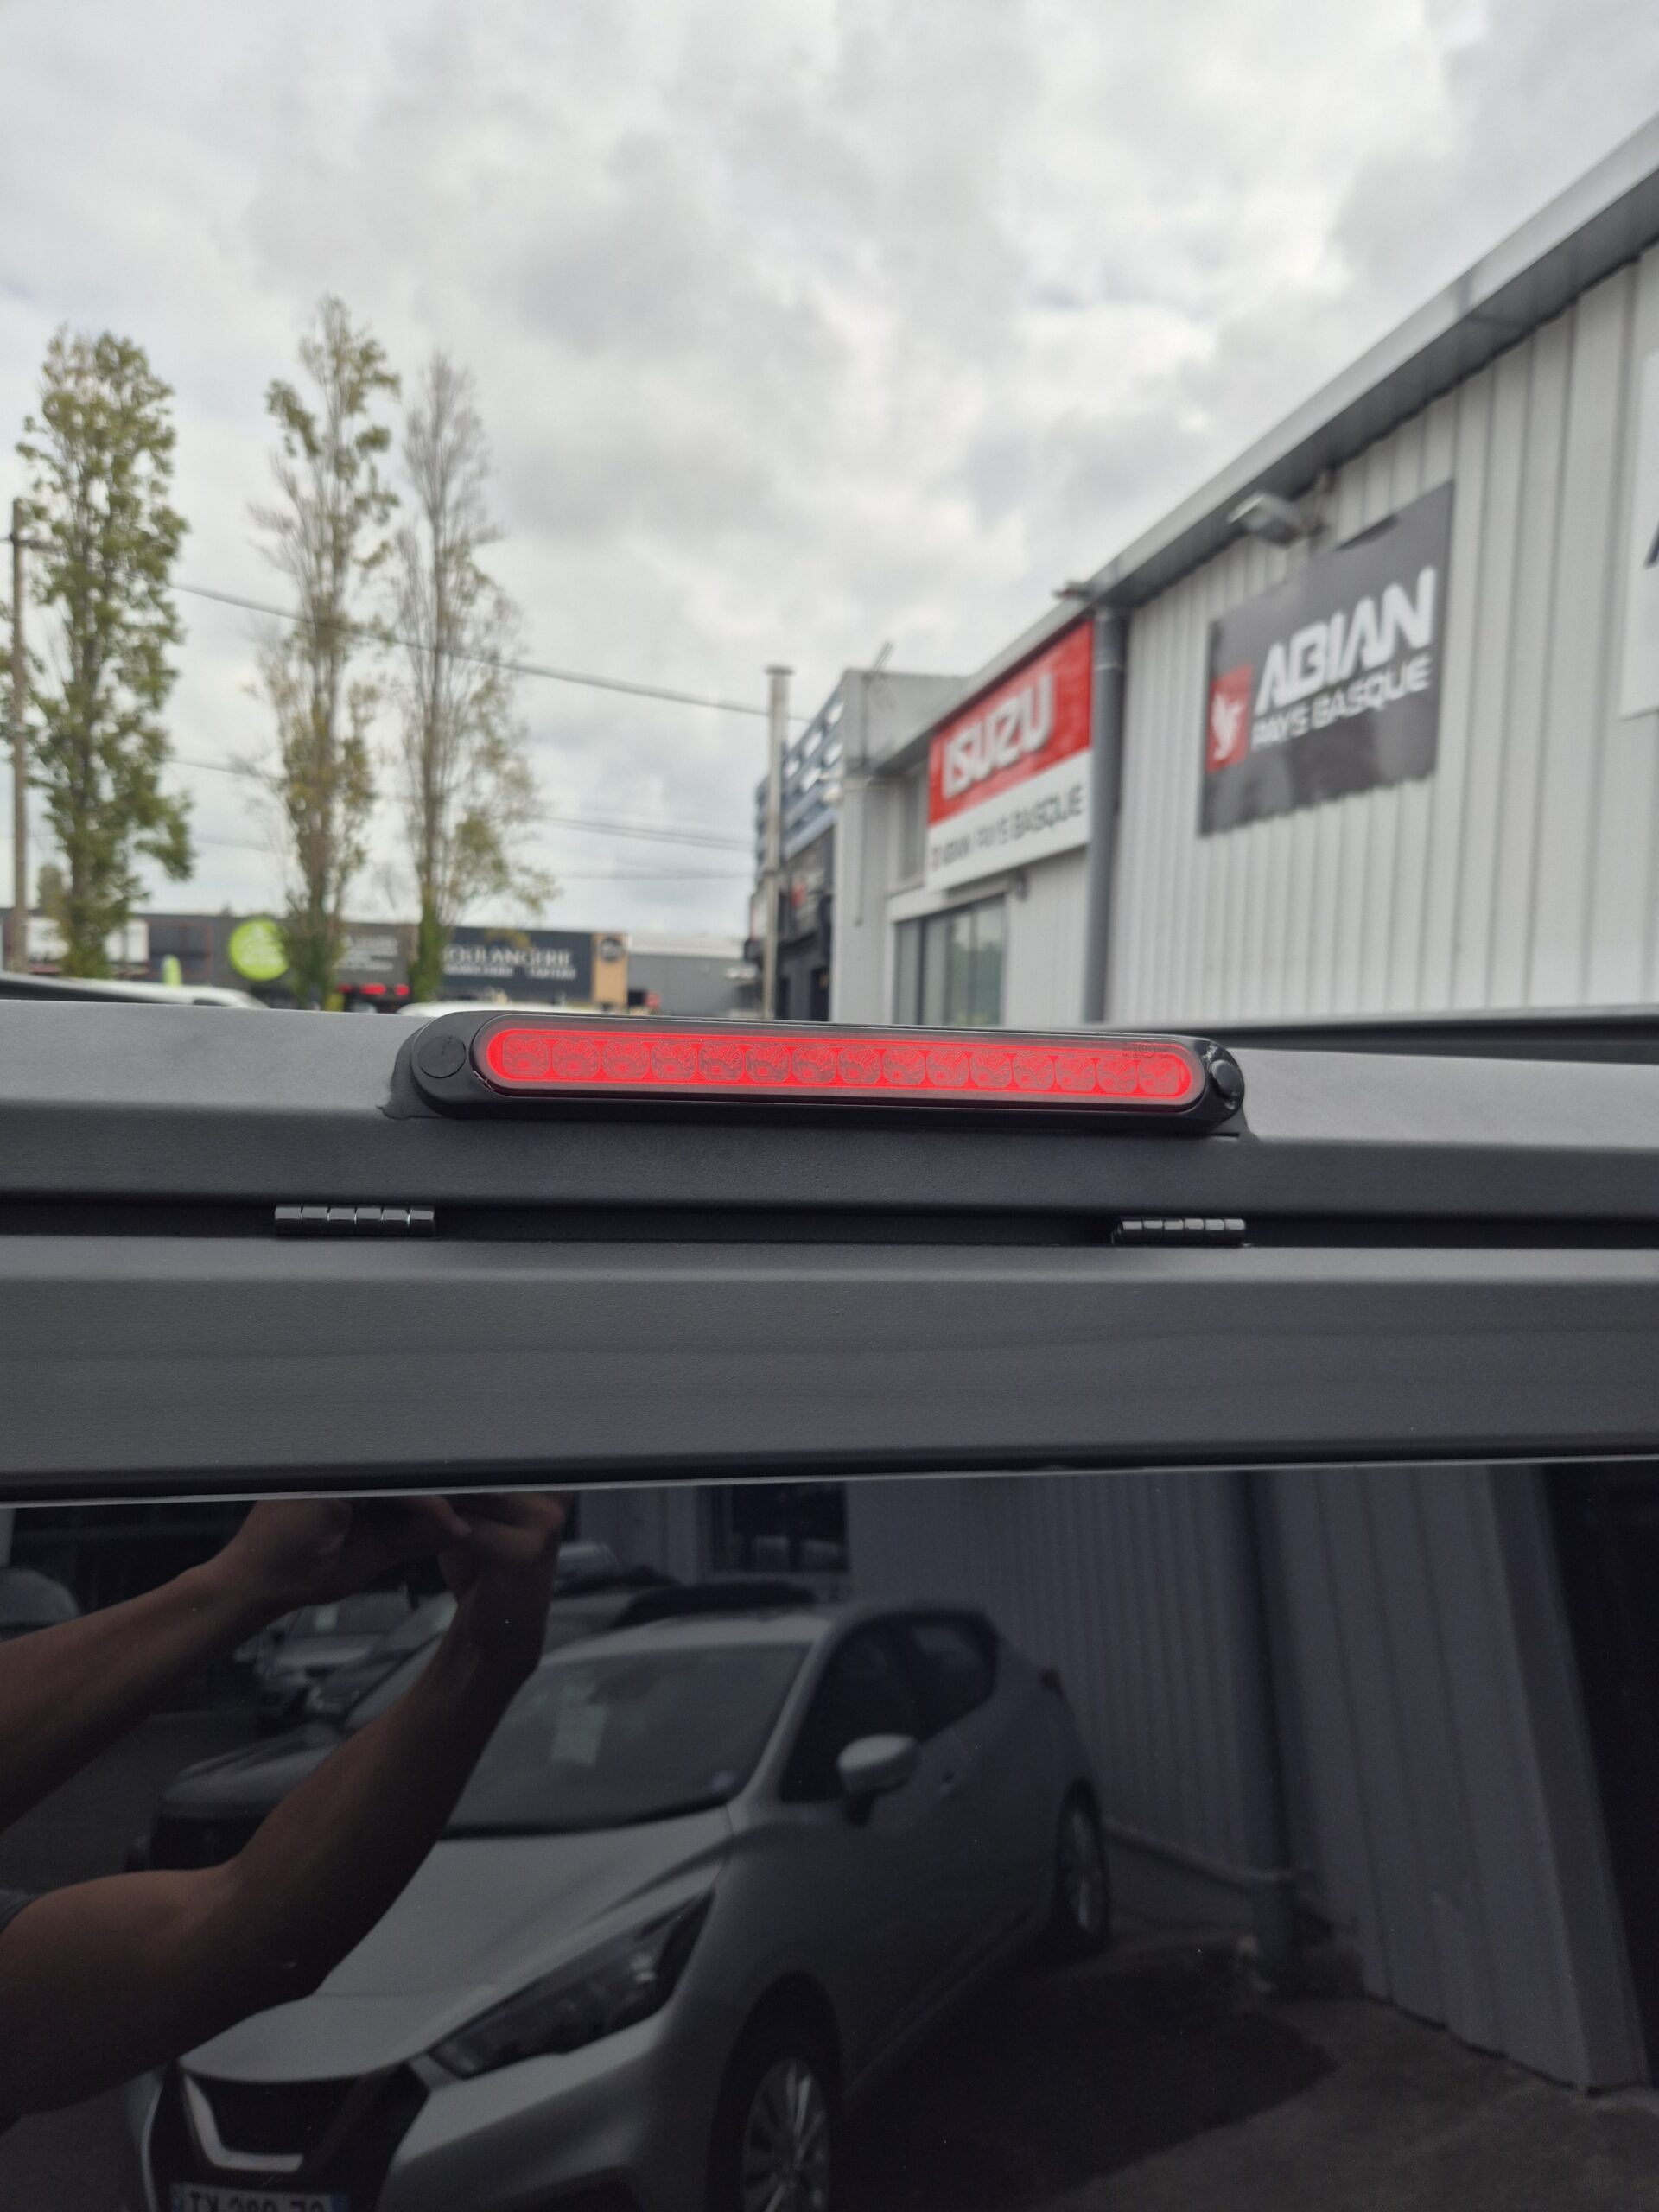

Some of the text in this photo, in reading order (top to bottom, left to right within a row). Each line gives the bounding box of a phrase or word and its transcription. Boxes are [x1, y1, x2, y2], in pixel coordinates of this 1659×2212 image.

[1255, 566, 1437, 716] ABIAN
[1312, 653, 1432, 730] BASQUE
[944, 673, 1054, 800] ISUZU
